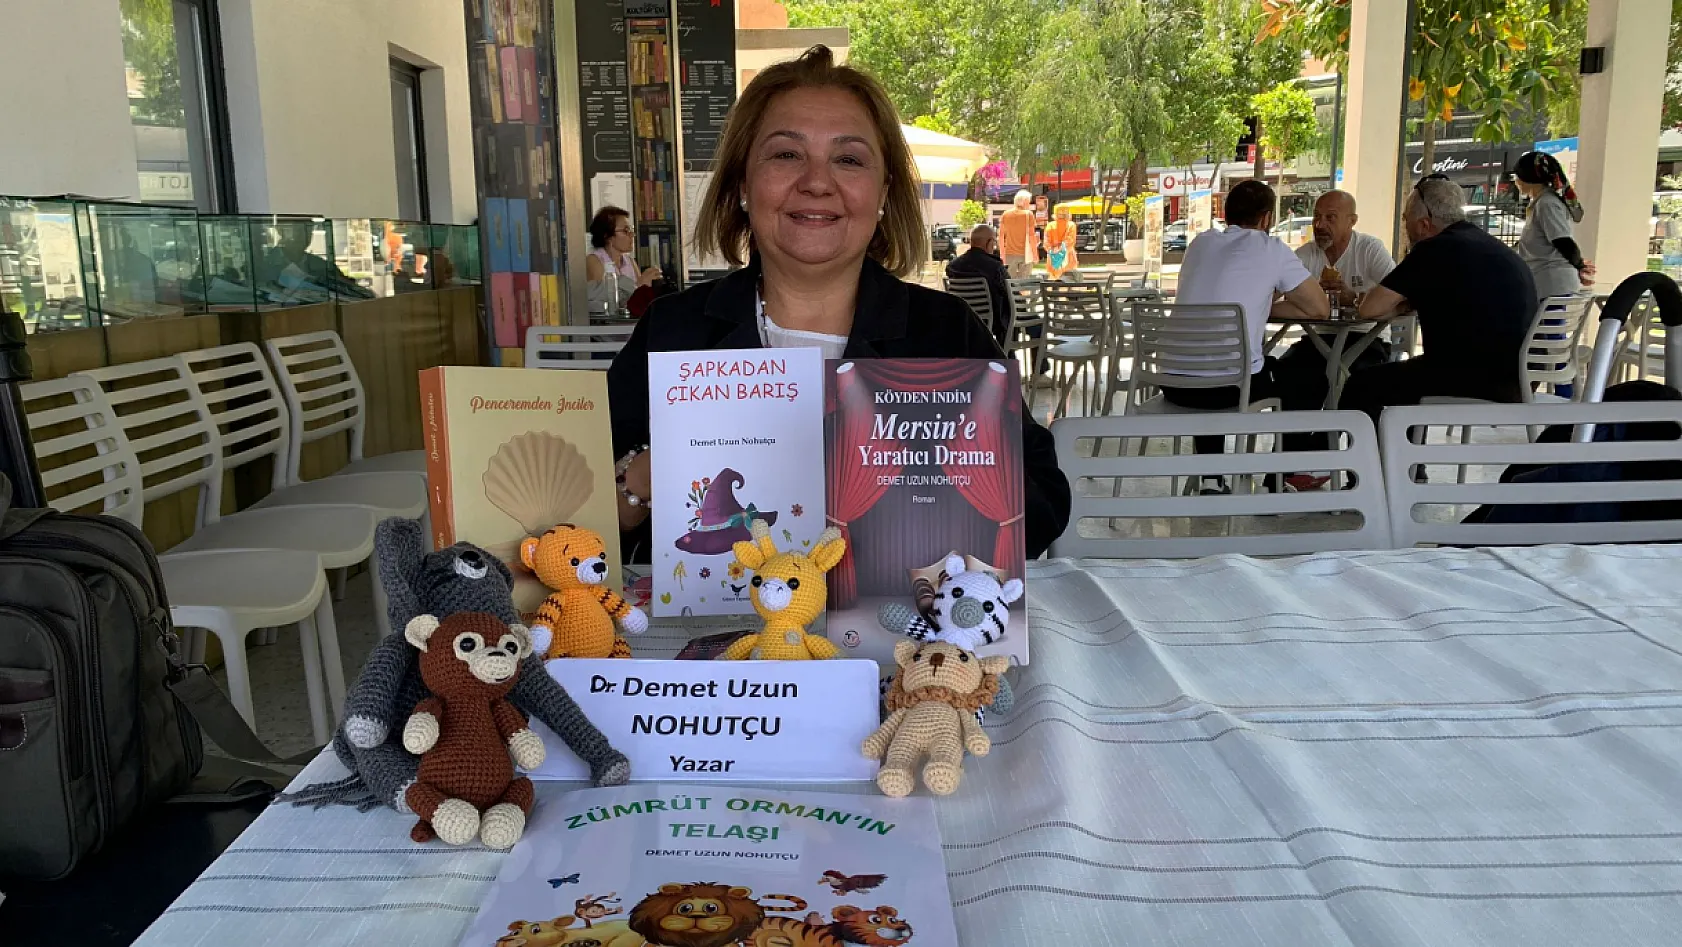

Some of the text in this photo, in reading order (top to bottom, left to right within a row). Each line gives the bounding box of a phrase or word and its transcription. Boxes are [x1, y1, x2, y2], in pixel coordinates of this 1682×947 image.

[679, 359, 786, 381] ŞAPKADAN
[666, 382, 798, 405] ÇIKAN BARIŞ
[875, 389, 972, 404] KÖYDEN İNDİM
[470, 394, 595, 415] Penceremden İnciler
[690, 437, 776, 447] Demet Uzun Nohutçu
[858, 445, 996, 466] Yaratıcı Drama
[877, 475, 971, 487] DEMET UZUN NOHUTÇU
[912, 495, 936, 503] Roman
[590, 674, 798, 698] Dr. Demet Uzun
[630, 714, 781, 740] NOHUTÇU
[669, 755, 735, 773] Yazar
[564, 795, 712, 830] ZÜMRÜT
[669, 822, 780, 843] TELAŞI
[645, 849, 800, 861] DEMET UZUN NOHUTÇU
